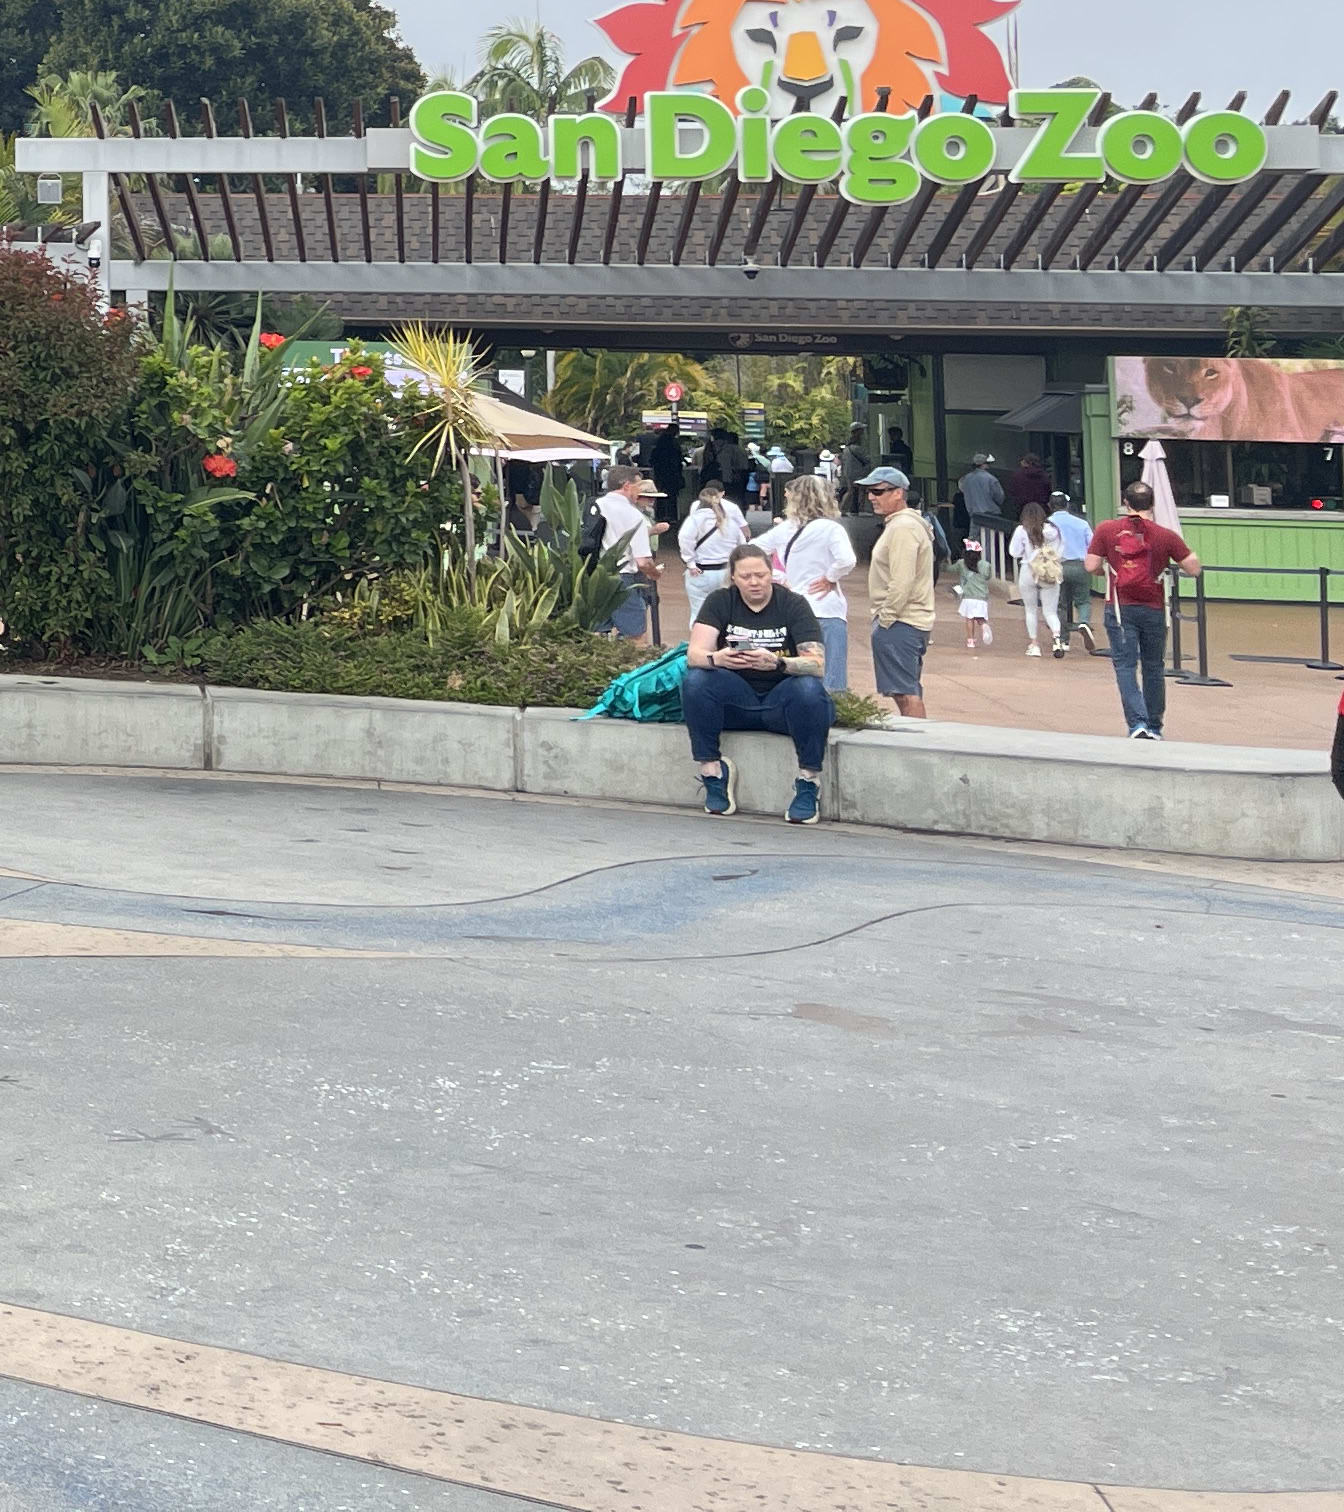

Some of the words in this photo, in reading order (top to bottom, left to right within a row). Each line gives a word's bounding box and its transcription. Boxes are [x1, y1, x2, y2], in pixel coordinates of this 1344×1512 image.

[408, 90, 623, 184] San
[645, 85, 997, 206] Diego
[1009, 88, 1268, 185] Zoo
[754, 333, 777, 343] San
[778, 333, 813, 345] Diego
[813, 334, 838, 344] Zoo
[668, 386, 678, 397] 4
[1123, 442, 1134, 456] 8
[1323, 447, 1334, 461] 7
